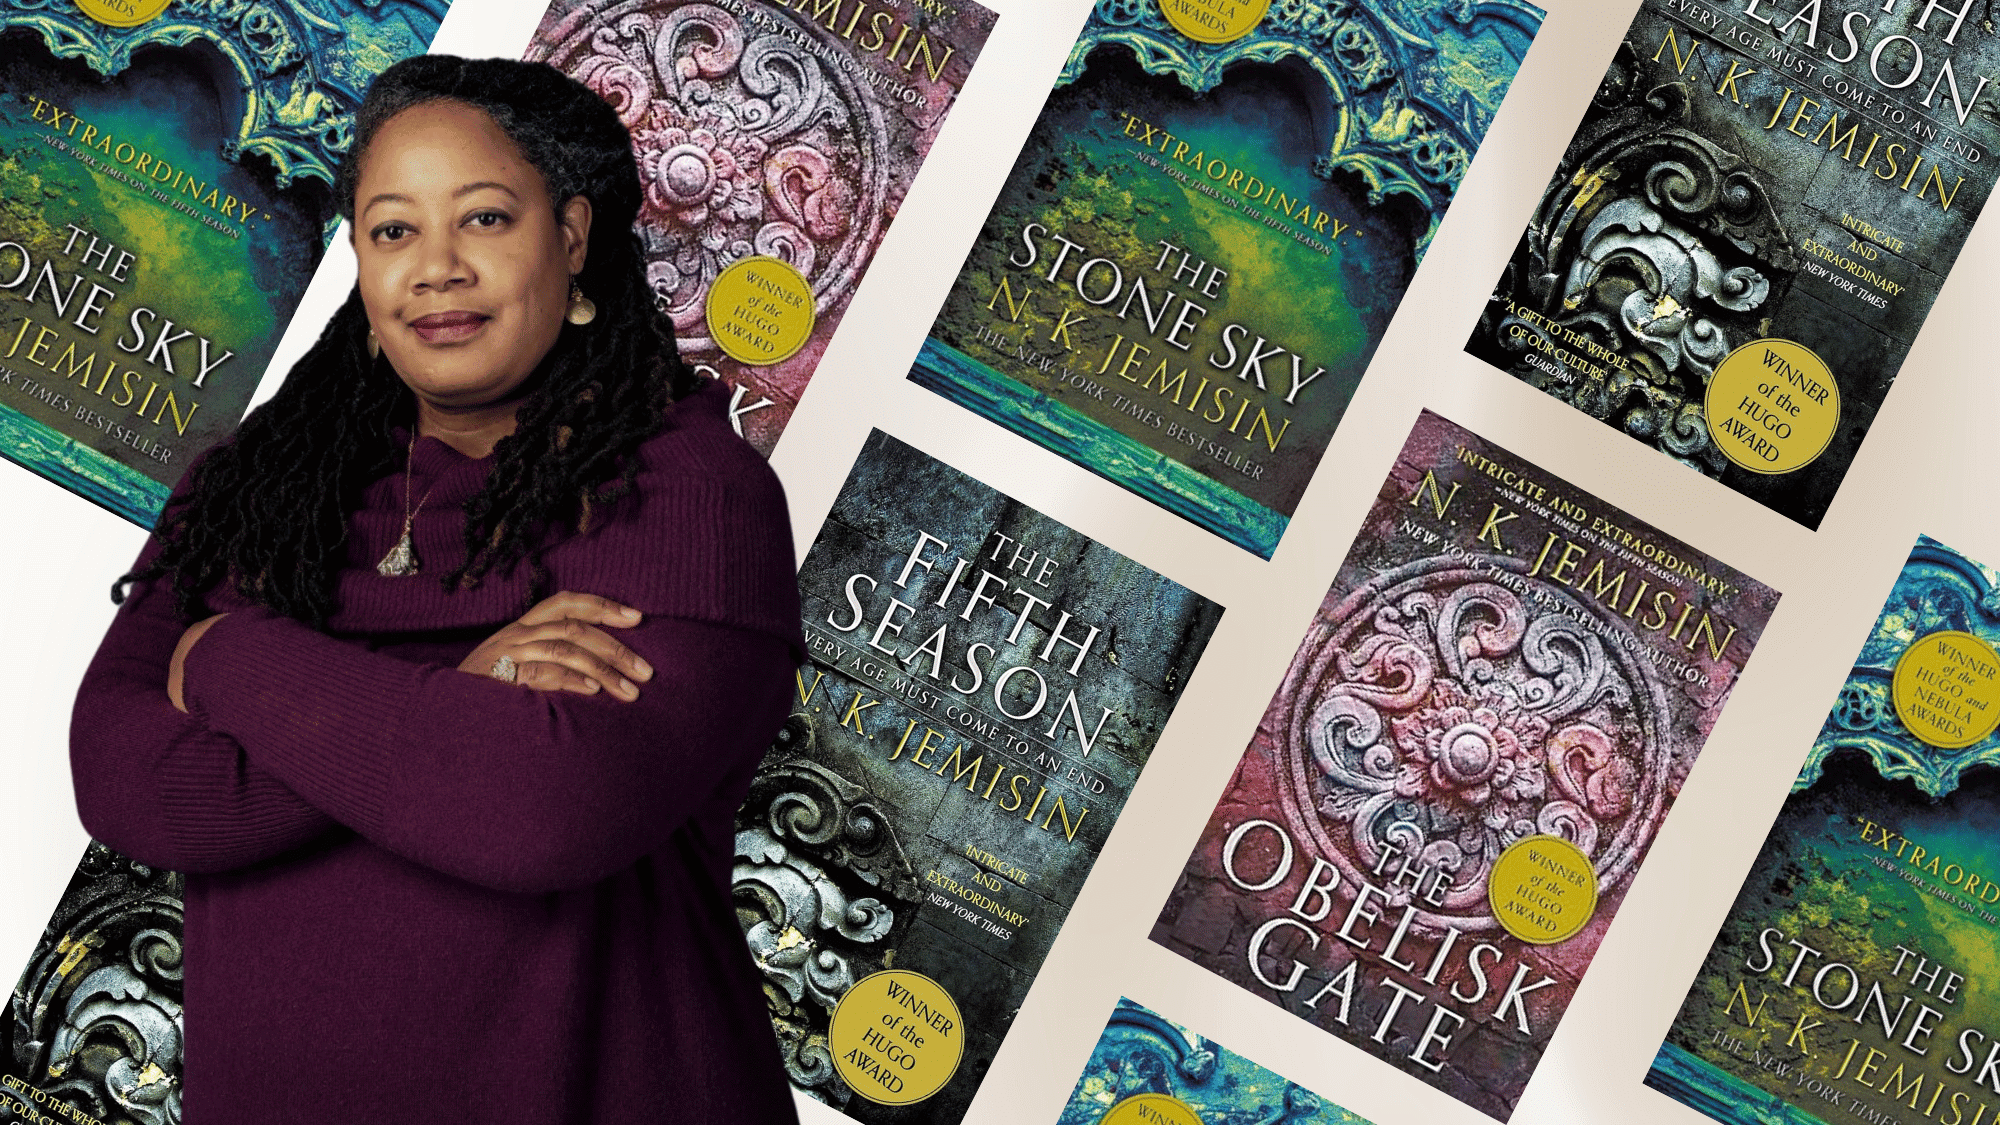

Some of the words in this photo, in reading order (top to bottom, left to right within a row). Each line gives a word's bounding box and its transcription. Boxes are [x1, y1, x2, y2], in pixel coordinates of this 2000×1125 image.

[1169, 0, 1229, 34] AWARDS
[749, 7, 857, 72] BESTSELLING
[860, 66, 930, 109] AUTHOR
[1742, 0, 1991, 126] ASON
[1651, 27, 1702, 81] N.
[1716, 59, 1757, 109] K.
[1763, 86, 1966, 212] JEMISIN
[1725, 25, 1763, 51] AGE
[1766, 45, 1818, 78] MUST
[1822, 74, 1876, 109] COME
[1881, 103, 1905, 124] TO
[1910, 121, 1938, 141] AN
[1941, 135, 1981, 163] END
[70, 147, 98, 167] YORK
[98, 162, 130, 182] TIMES
[129, 178, 148, 192] ON
[150, 188, 168, 203] THE
[170, 198, 200, 218] FIFTH
[200, 214, 240, 239] SEASON
[1162, 163, 1190, 184] YORK
[1190, 179, 1221, 199] TIMES
[1221, 193, 1239, 209] ON
[1242, 204, 1260, 220] THE
[1262, 215, 1292, 235] FIFTH
[1292, 231, 1332, 256] SEASON
[60, 223, 136, 283] THE
[1152, 239, 1228, 299] THE
[1846, 237, 1878, 261] AND
[746, 270, 803, 309] WINNER
[747, 296, 764, 308] of
[762, 303, 783, 318] the
[1802, 260, 1830, 278] NEW
[1828, 272, 1858, 294] YORK
[1856, 287, 1888, 309] TIMES
[0, 241, 115, 334] ONE
[117, 307, 234, 387] SKY
[721, 321, 775, 353] AWARD
[733, 305, 780, 336] HUGO
[1009, 223, 1207, 351] STONE
[1209, 324, 1325, 404] SKY
[1509, 325, 1529, 343] OF
[1527, 334, 1556, 356] OUR
[1517, 306, 1546, 327] GIFT
[1544, 319, 1562, 336] TO
[1563, 328, 1591, 349] THE
[1587, 340, 1630, 373] WHOLE
[4, 317, 199, 436] JEMISIN
[986, 276, 1036, 328] N.
[1049, 307, 1088, 355] K.
[1096, 333, 1291, 453] JEMISIN
[1524, 353, 1577, 385] GUARDIAN
[1762, 349, 1829, 405] WINNER
[20, 377, 73, 412] TIMES
[74, 405, 172, 464] BESTSELLER
[975, 325, 1009, 351] THE
[1011, 342, 1062, 375] NEW
[1060, 364, 1109, 401] YORK
[1112, 394, 1161, 428] TIMES
[1166, 421, 1264, 481] BESTSELLER
[1737, 395, 1792, 439] HUGO
[1757, 383, 1780, 399] of
[1775, 393, 1801, 418] the
[1719, 416, 1780, 462] AWARD
[1548, 496, 1587, 522] AND
[990, 530, 1060, 588] THE
[1409, 468, 1462, 526] N.
[1476, 502, 1520, 555] K.
[1528, 532, 1737, 663] JEMISIN
[1580, 529, 1598, 543] ON
[1598, 537, 1619, 554] THE
[1644, 563, 1683, 587] SEASON
[892, 529, 1102, 678] FIFTH
[1399, 516, 1440, 546] NEW
[1441, 540, 1485, 574] YORK
[1482, 563, 1534, 599] TIMES
[1533, 586, 1639, 651] BESTSELLING
[1642, 643, 1712, 688] AUTHOR
[826, 573, 1115, 758] SEASON
[1915, 666, 1964, 699] HUGO
[1965, 697, 1989, 711] and
[1937, 640, 1997, 681] WINNER
[1942, 666, 1959, 678] of
[1957, 671, 1976, 686] the
[804, 629, 847, 660] VERY
[849, 656, 887, 683] AGE
[890, 675, 942, 709] MUST
[946, 705, 1000, 741] COME
[1005, 734, 1029, 755] TO
[1033, 751, 1062, 772] AN
[1066, 766, 1105, 794] END
[1905, 703, 1965, 739] AWARDS
[1914, 685, 1972, 725] NEBULA
[840, 690, 881, 740] K.
[887, 717, 1090, 843] JEMISIN
[970, 868, 1002, 892] AND
[1367, 839, 1455, 907] THE
[1529, 849, 1586, 888] WINNER
[1530, 875, 1546, 887] of
[1545, 882, 1565, 897] the
[1898, 868, 1926, 888] YORK
[1927, 884, 1958, 904] TIMES
[1957, 897, 1976, 913] ON
[1978, 909, 1999, 924] THE
[926, 892, 954, 910] NEW
[952, 904, 982, 925] YORK
[981, 918, 1012, 941] TIMES
[1222, 819, 1558, 1036] OBELISK
[1504, 900, 1557, 932] AWARD
[1516, 884, 1563, 915] HUGO
[1247, 918, 1465, 1073] GATE
[1889, 944, 1964, 1004] THE
[881, 1014, 904, 1030] of
[899, 1025, 925, 1049] the
[887, 979, 953, 1037] WINNER
[1722, 981, 1772, 1033] N.
[1786, 1012, 1824, 1060] K.
[1746, 927, 1944, 1056] STONE
[1946, 1029, 2000, 1094] SK
[843, 1048, 904, 1094] AWARD
[861, 1027, 916, 1071] HUGO
[1712, 1028, 1746, 1056] THE
[1748, 1048, 1799, 1079] NEW
[1797, 1069, 1846, 1106] YORK
[2, 1074, 30, 1094] GIFT
[29, 1086, 47, 1103] TO
[48, 1095, 74, 1117] THE
[12, 1102, 40, 1123] OUR
